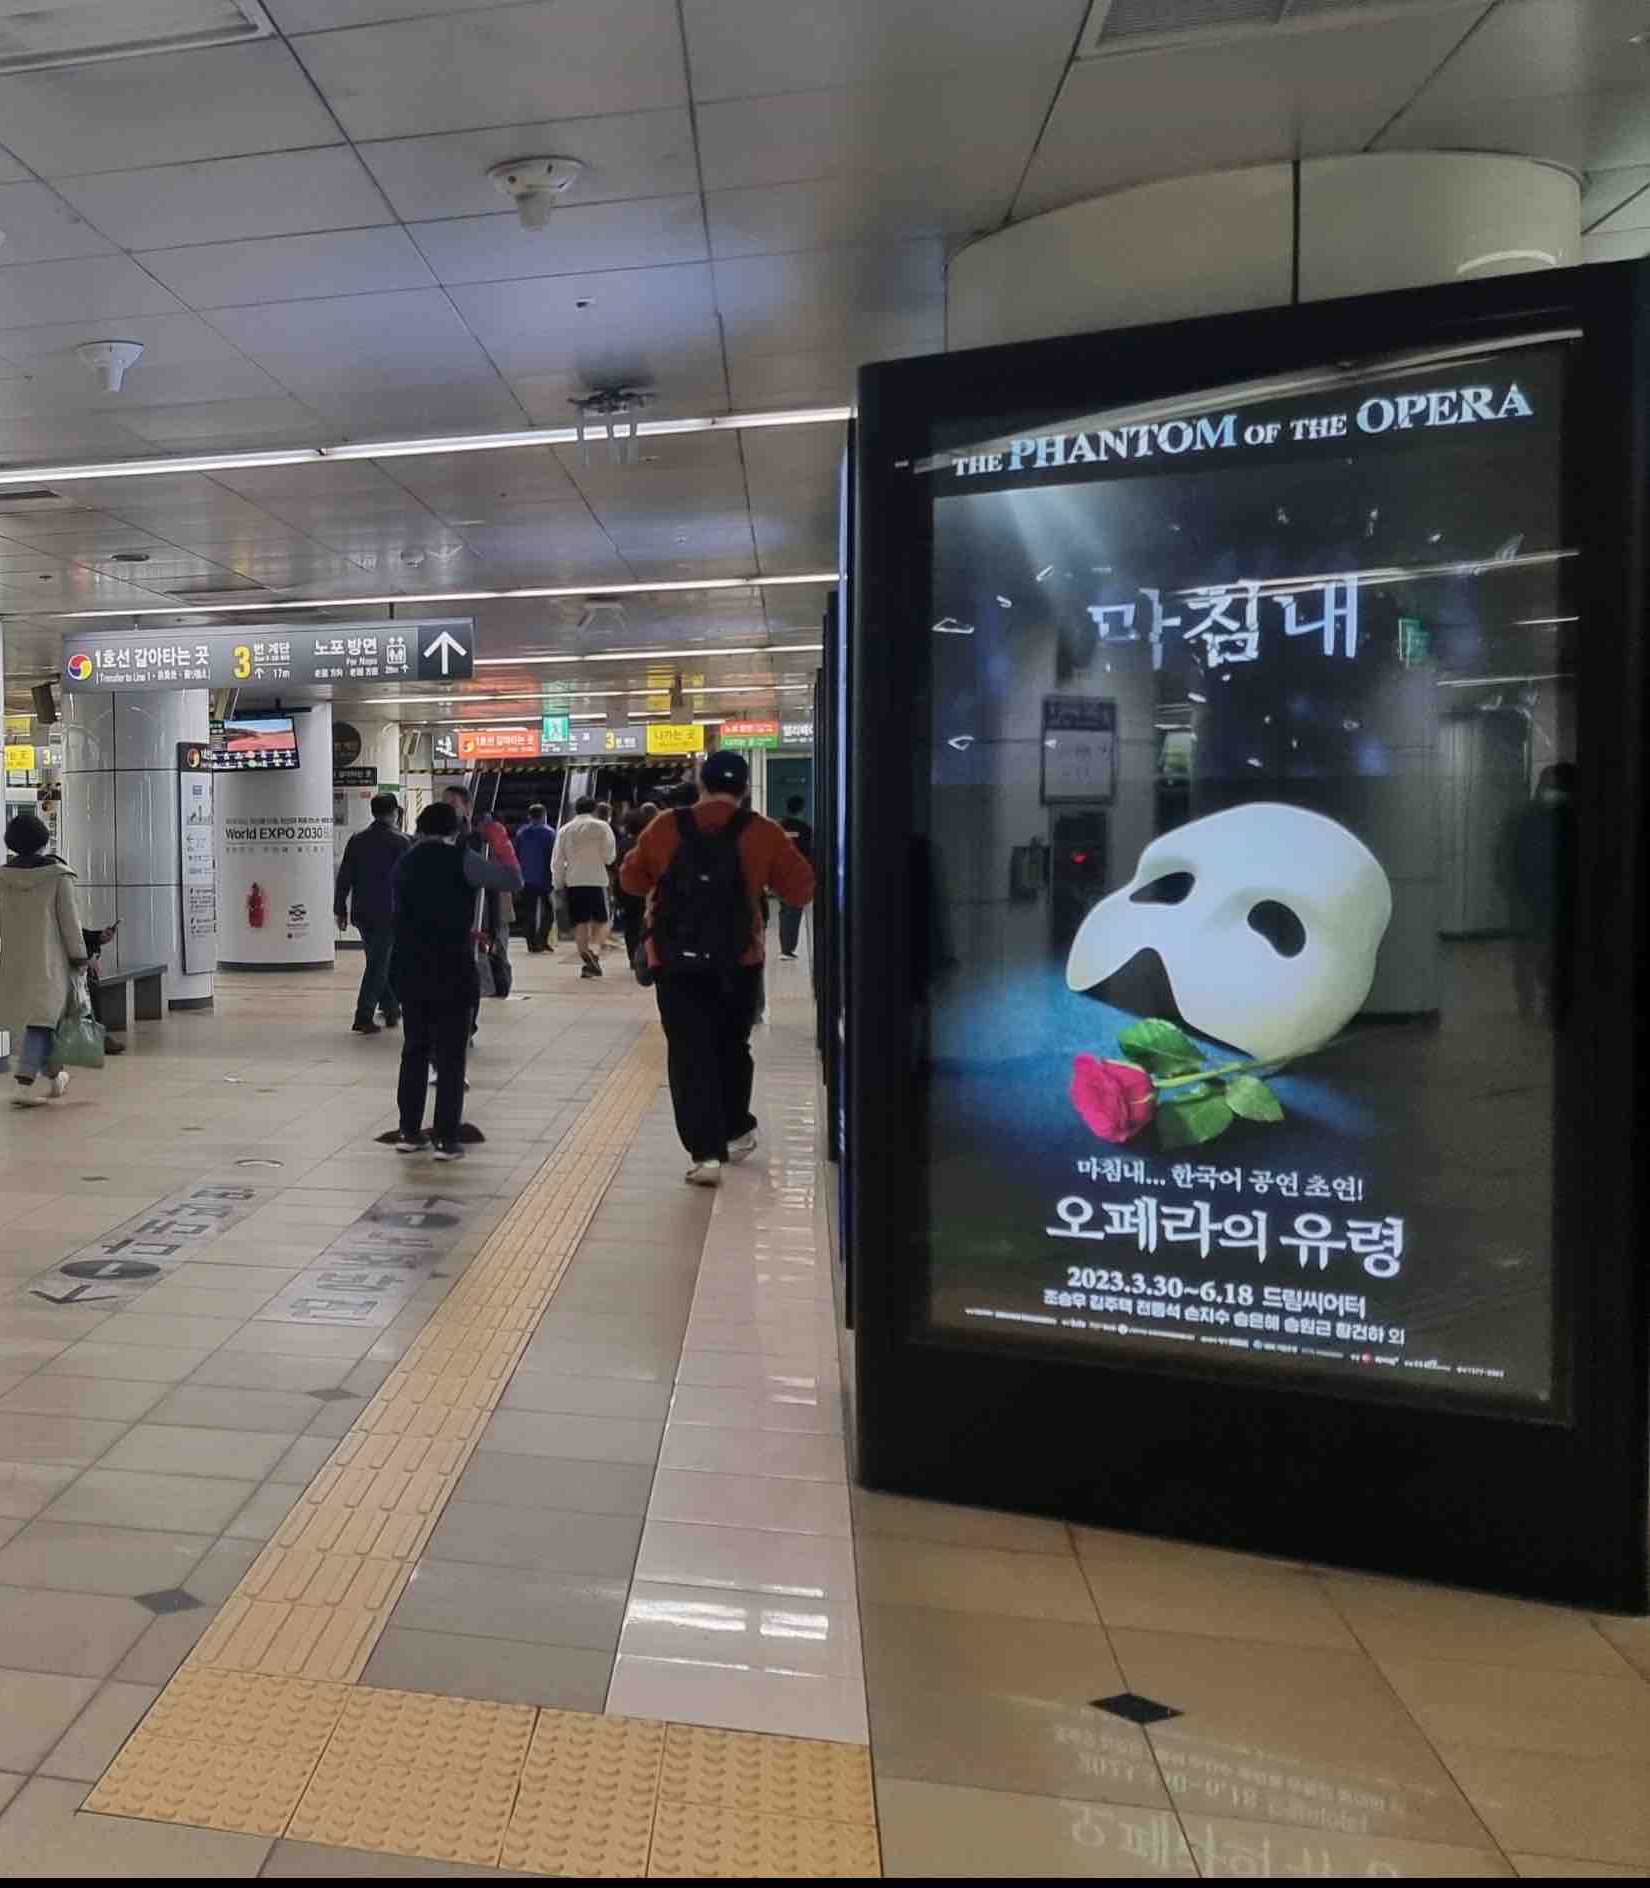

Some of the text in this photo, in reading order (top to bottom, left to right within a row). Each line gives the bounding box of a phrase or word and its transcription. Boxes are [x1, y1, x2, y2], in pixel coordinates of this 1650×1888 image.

[952, 383, 1534, 477] THE PHANTOM OF THE OPERA
[1087, 573, 1360, 670] 마침내
[95, 645, 210, 669] 1호선 갈아타는 곳
[233, 646, 252, 679] 3
[314, 636, 378, 656] 노포 방면
[605, 730, 616, 749] 3
[225, 827, 323, 840] World EXPO 2030
[1077, 1156, 1364, 1202] 마침내... 한국어 공연 초연!
[1045, 1195, 1404, 1279] 오페라의 유령
[1066, 1266, 1366, 1320] 2023.3.30~6.18 드림씨어터
[1183, 1304, 1230, 1327] 손지수
[1387, 1327, 1405, 1347] 외
